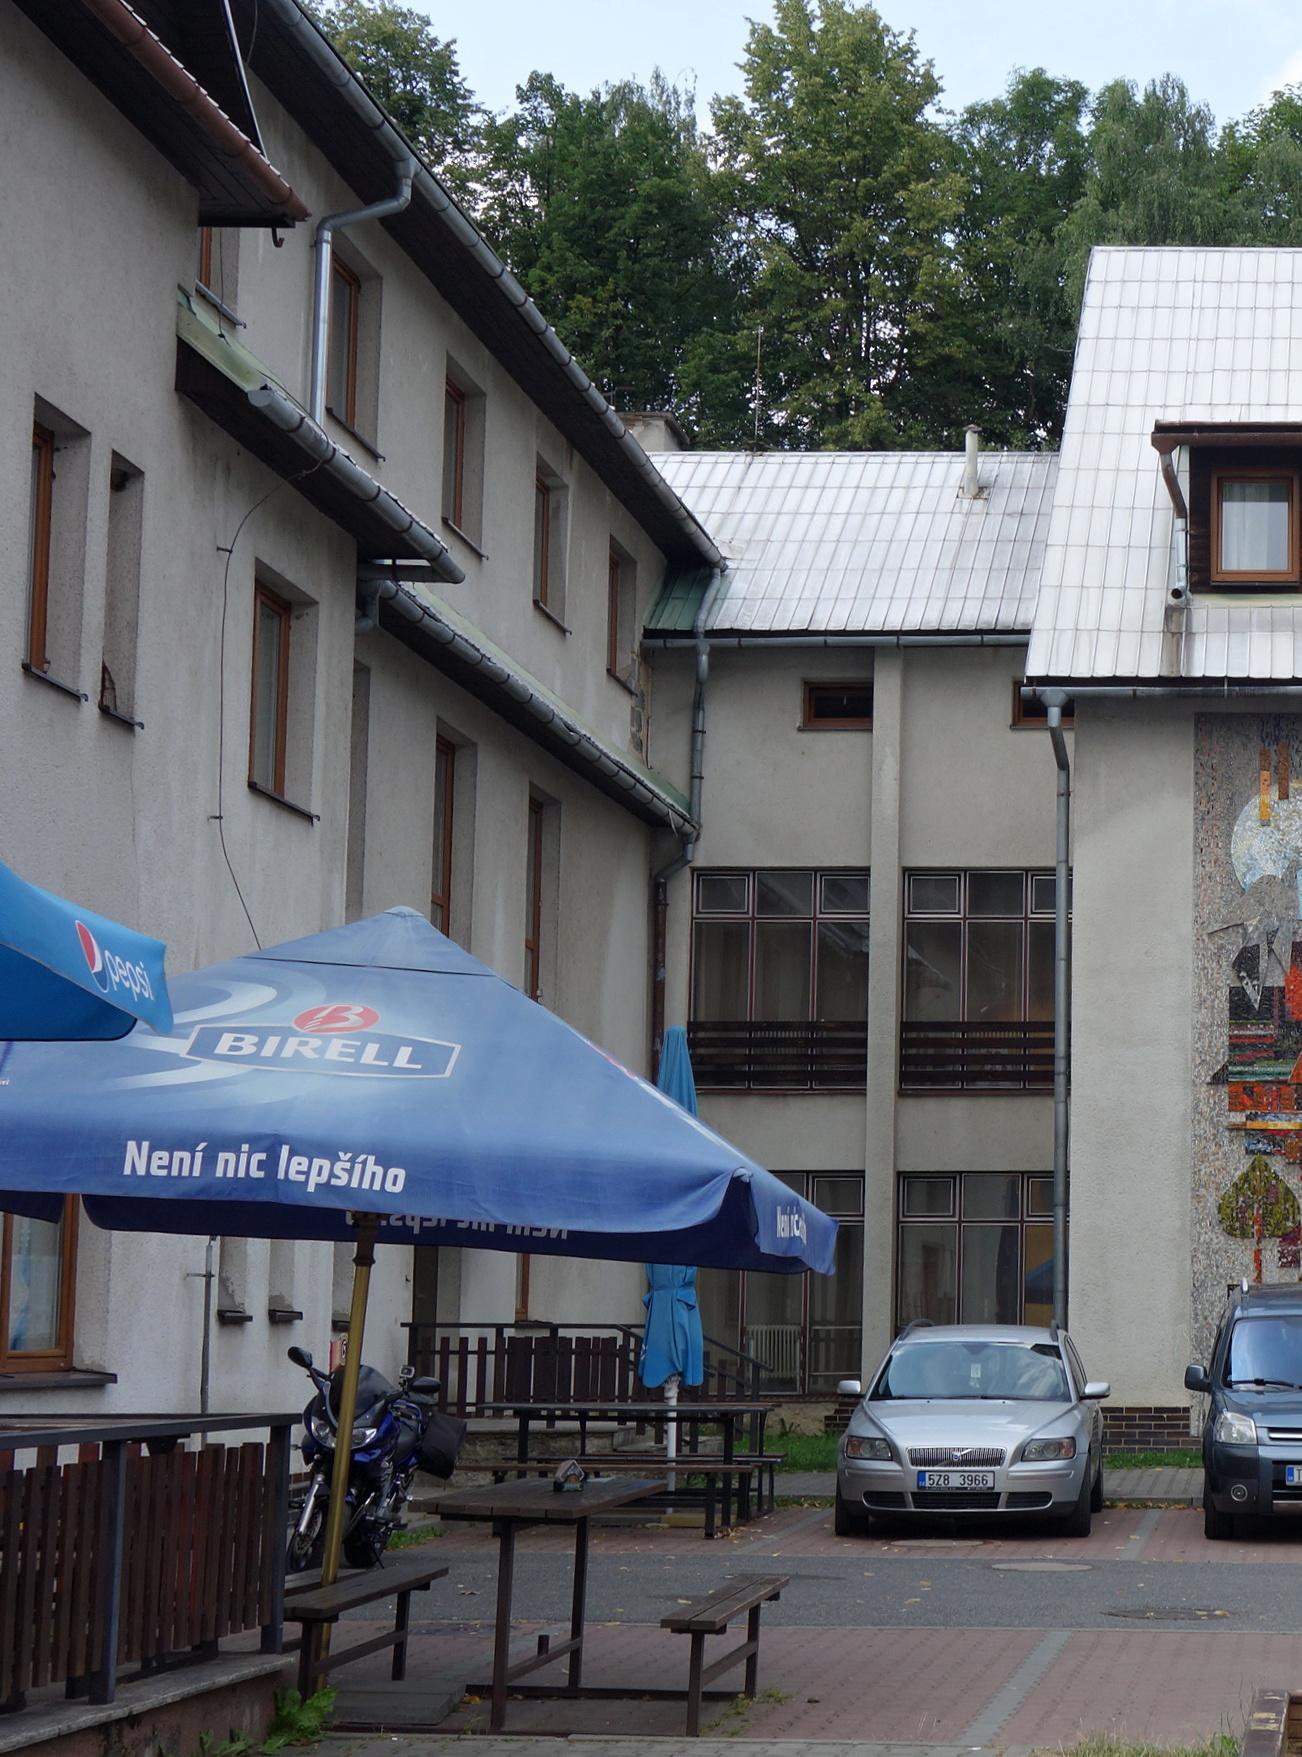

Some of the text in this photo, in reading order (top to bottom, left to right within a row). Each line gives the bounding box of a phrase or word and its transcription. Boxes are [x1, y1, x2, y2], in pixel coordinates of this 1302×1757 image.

[104, 949, 154, 1003] pepsi
[213, 1032, 422, 1069] BIRELL
[123, 1140, 406, 1193] Není nic lepšího
[928, 1474, 950, 1486] 5Z8
[959, 1474, 989, 1486] 3966
